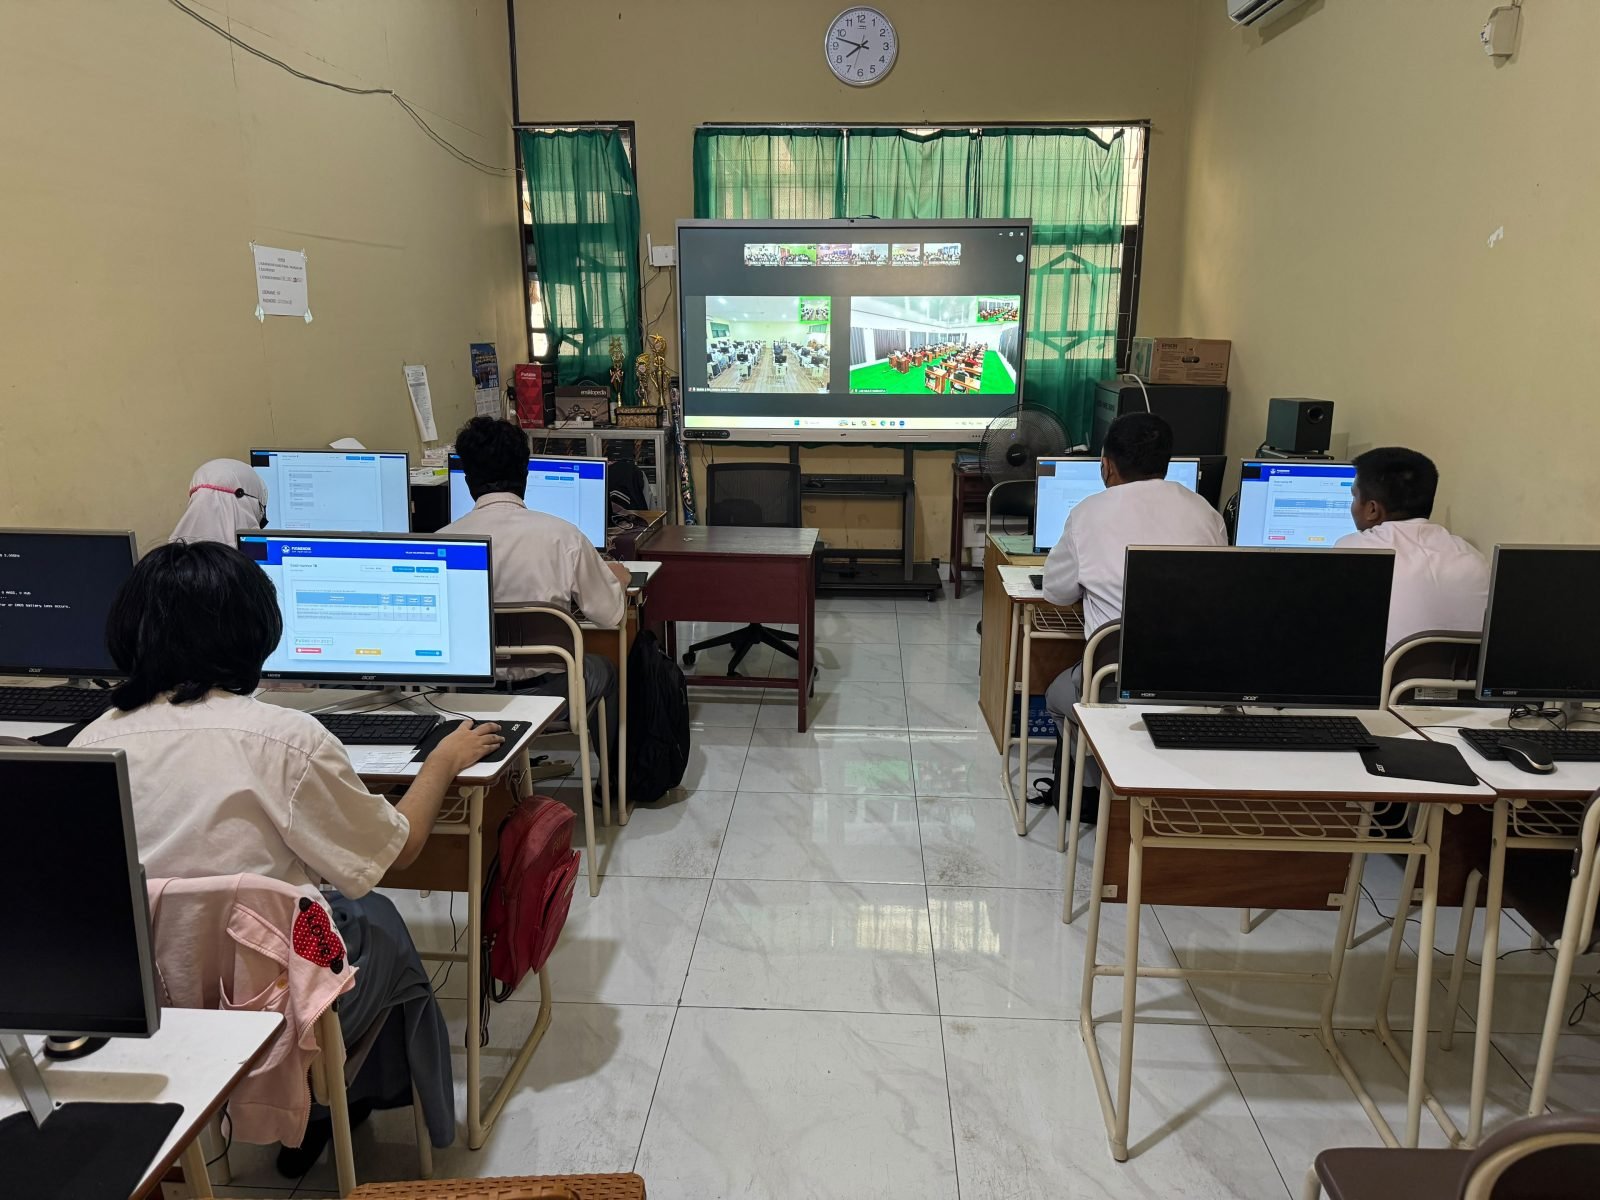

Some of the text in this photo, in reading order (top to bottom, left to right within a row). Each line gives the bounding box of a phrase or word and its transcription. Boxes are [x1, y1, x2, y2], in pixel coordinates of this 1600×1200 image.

[845, 19, 853, 27] 11
[857, 15, 866, 23] 12
[872, 18, 877, 27] 1
[837, 29, 847, 37] 10
[879, 29, 886, 37] 2
[832, 42, 839, 50] 9
[883, 42, 890, 51] 3
[836, 55, 843, 63] 8
[878, 55, 885, 63] 4
[846, 65, 852, 73] 7
[857, 69, 863, 77] 6
[869, 65, 876, 73] 5
[307, 914, 330, 957] LOVE
